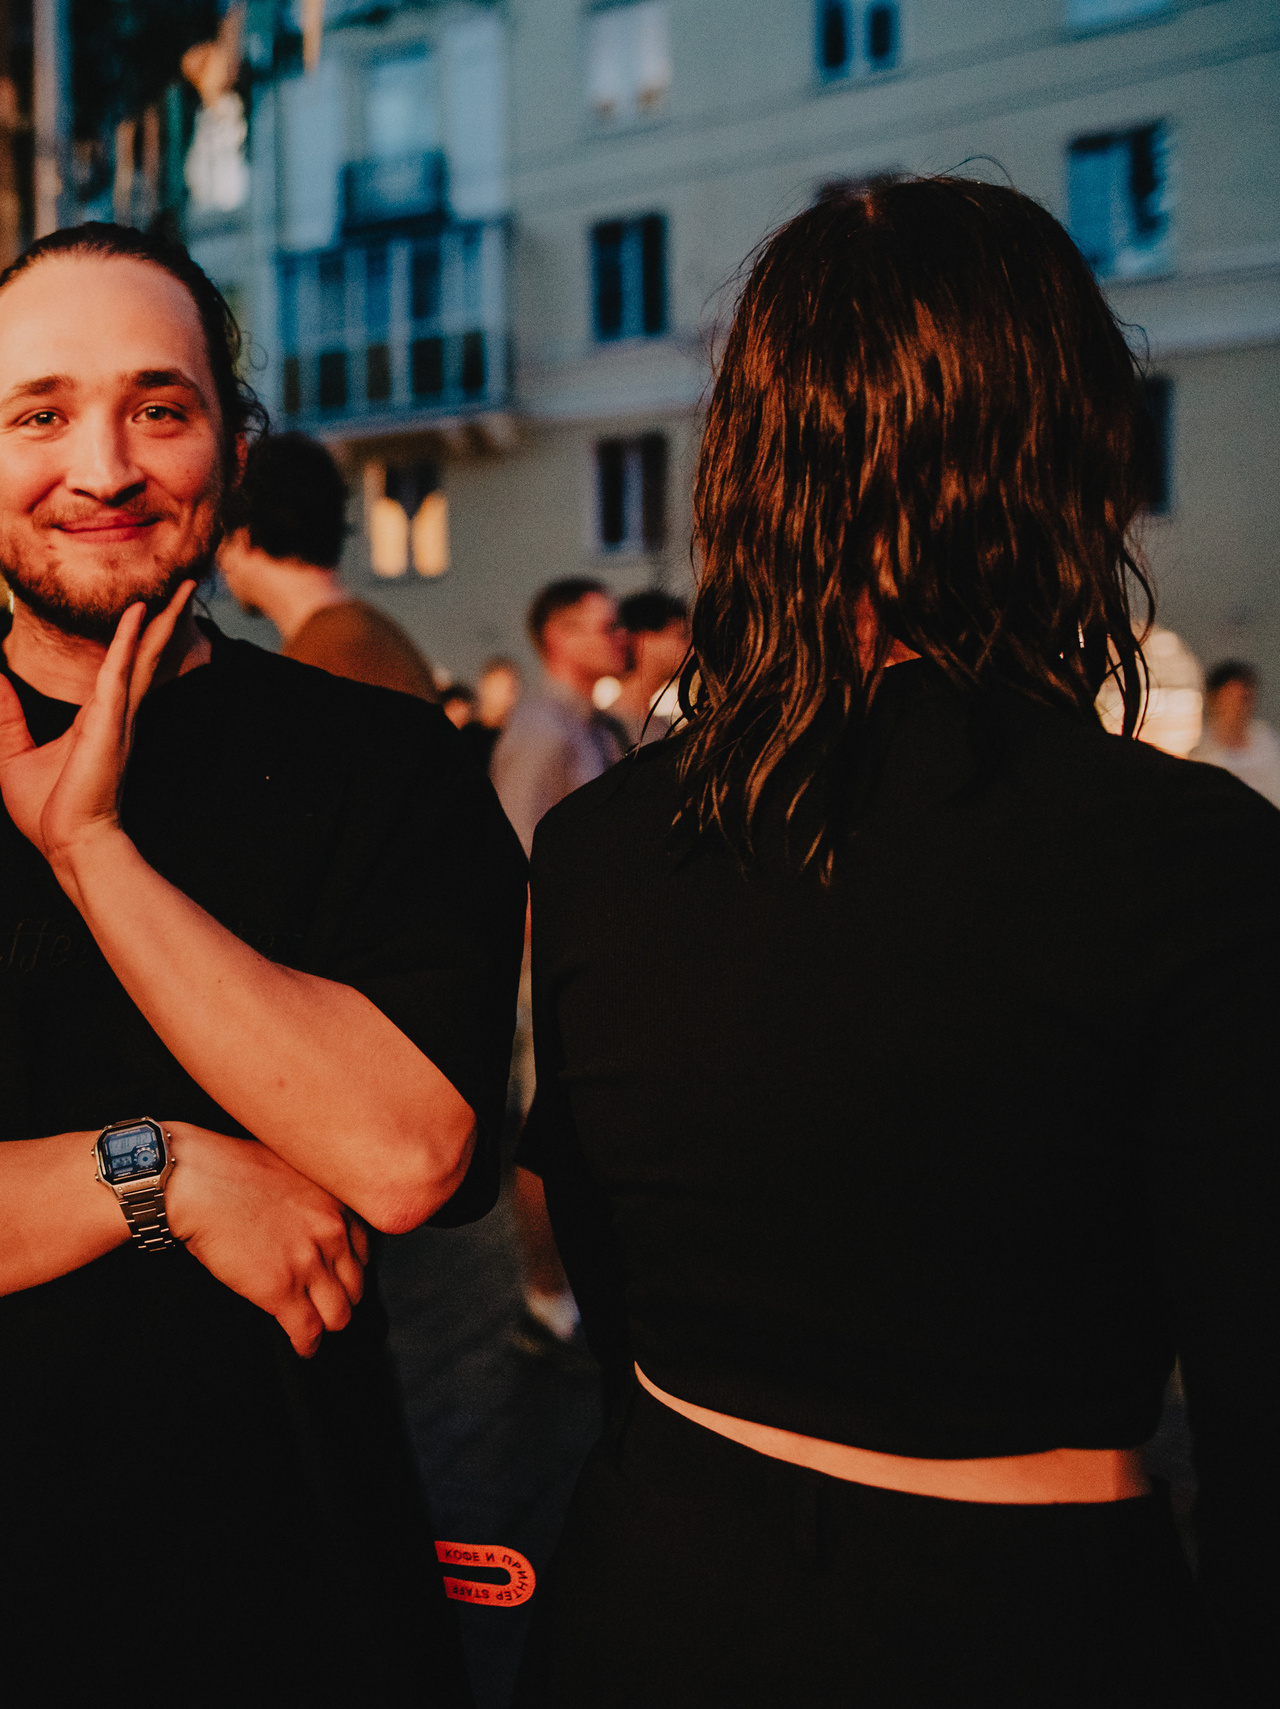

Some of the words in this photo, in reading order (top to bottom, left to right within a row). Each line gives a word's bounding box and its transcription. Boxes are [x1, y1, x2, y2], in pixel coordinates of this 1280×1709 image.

[444, 1549, 480, 1562] КОФЕ
[485, 1552, 495, 1562] И
[496, 1554, 528, 1601] ПРИНТЕР
